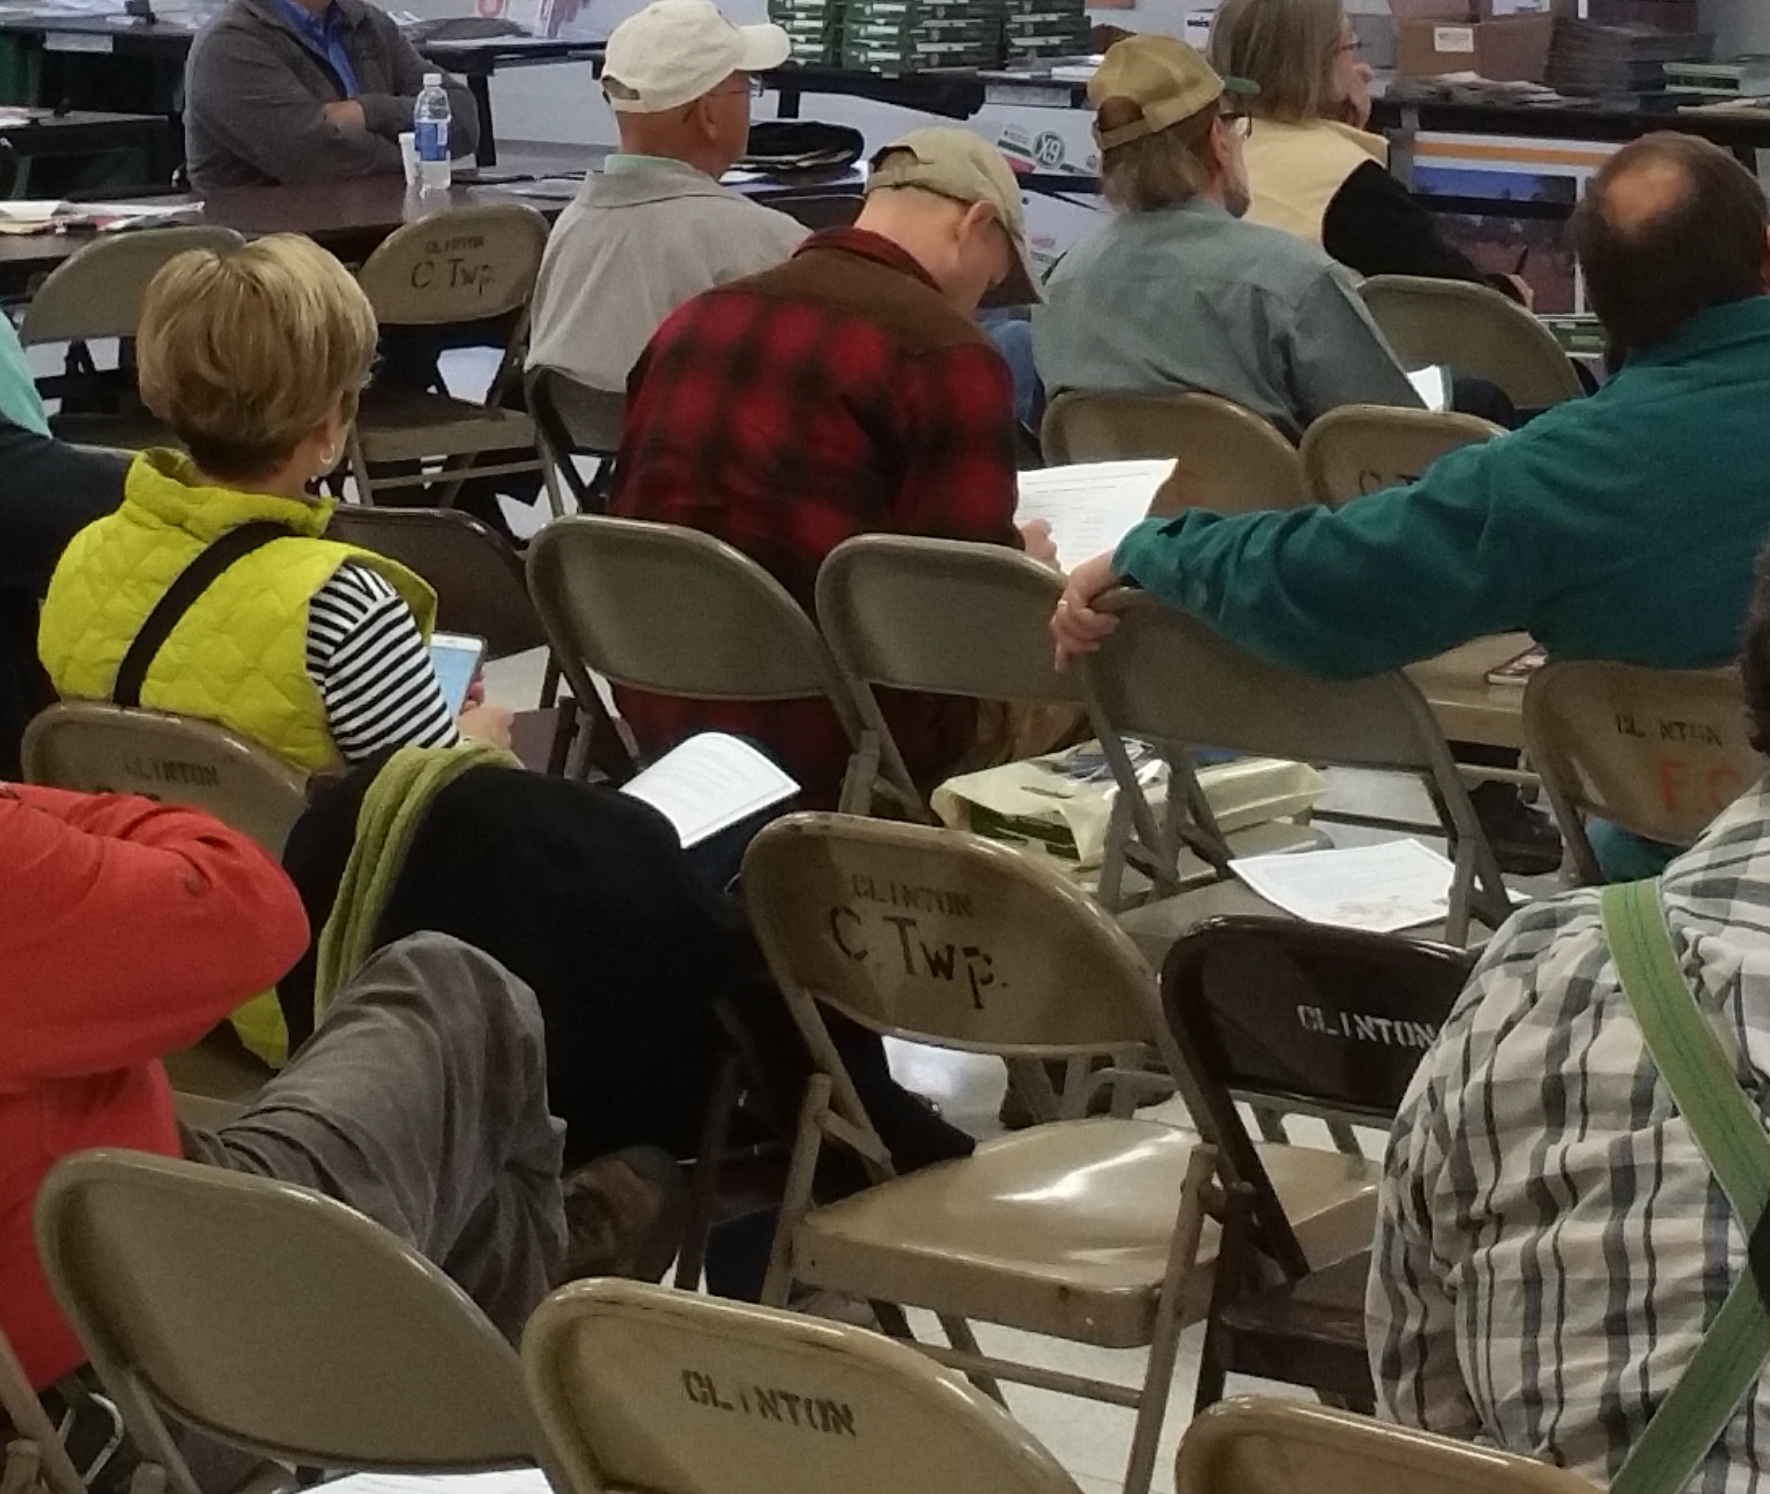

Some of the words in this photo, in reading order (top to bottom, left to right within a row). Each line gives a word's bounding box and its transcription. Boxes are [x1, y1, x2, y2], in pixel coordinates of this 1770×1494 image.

[1037, 134, 1062, 163] X9
[851, 873, 974, 920] CLINTON
[1296, 1005, 1435, 1048] CLINTON
[682, 1369, 857, 1437] CLINTON
